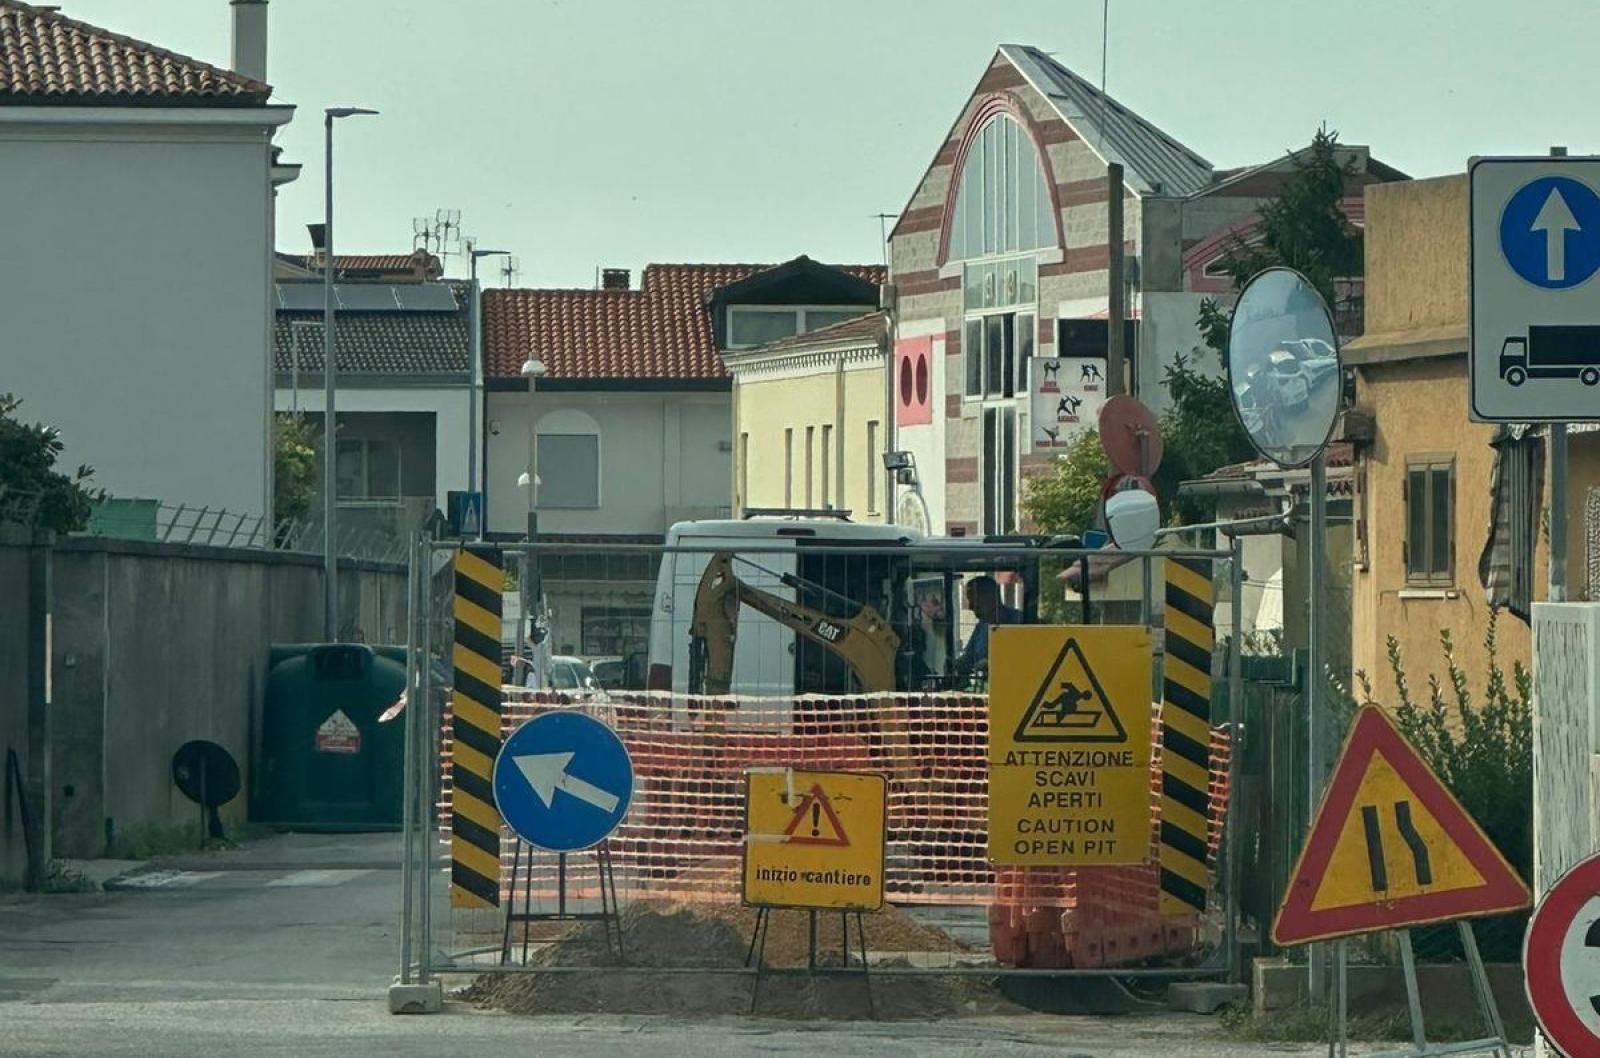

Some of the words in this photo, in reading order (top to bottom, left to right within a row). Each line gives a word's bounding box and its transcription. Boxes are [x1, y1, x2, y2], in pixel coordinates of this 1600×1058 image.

[818, 622, 840, 640] CAT
[1004, 750, 1134, 767] ATTENZIONE
[1035, 770, 1095, 787] SCAVI
[1027, 792, 1102, 808] APERTI
[1017, 818, 1114, 834] CAUTION
[1014, 840, 1075, 855] OPEN
[1084, 840, 1117, 855] PIT
[756, 863, 797, 882] inizio
[806, 869, 871, 886] cantiere
